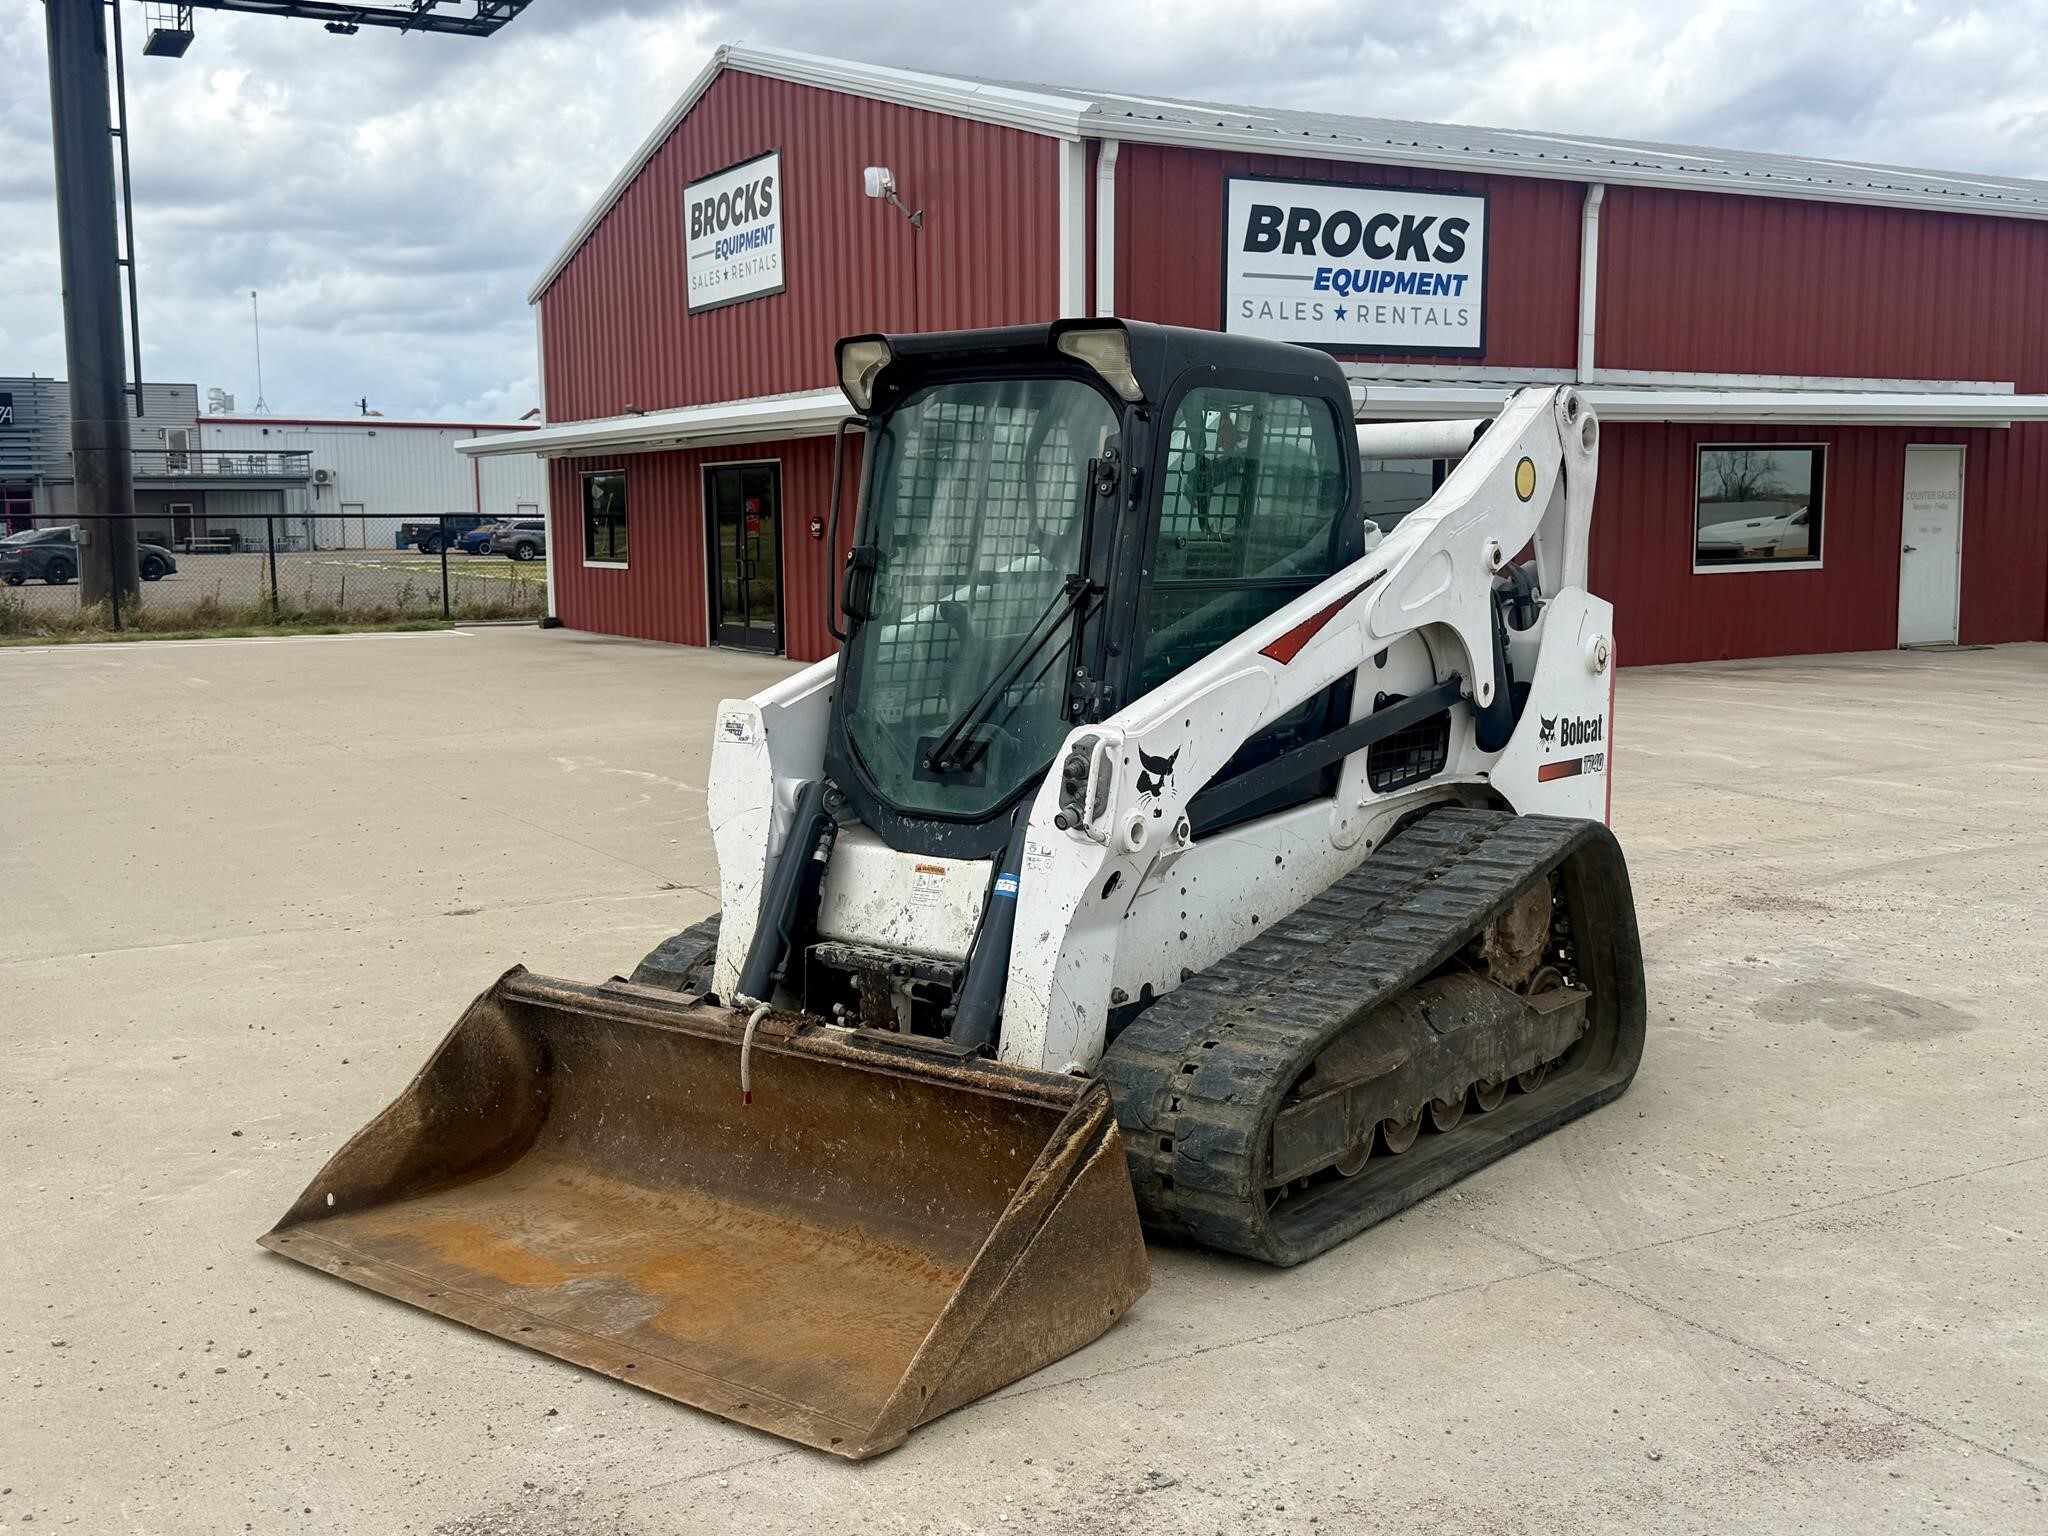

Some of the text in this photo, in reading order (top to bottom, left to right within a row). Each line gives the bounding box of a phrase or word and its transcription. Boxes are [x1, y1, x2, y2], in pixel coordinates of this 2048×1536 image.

[690, 175, 774, 241] BROCKS
[714, 223, 775, 262] EQUIPMENT
[1243, 203, 1471, 264] BROCKS
[692, 253, 777, 290] SALES RENTALS
[1313, 267, 1469, 298] EQUIPMENT
[1241, 300, 1469, 326] SALES RENTALS
[1937, 490, 1957, 500] SALES
[1560, 714, 1603, 747] Bobcat
[1583, 752, 1604, 774] T740
